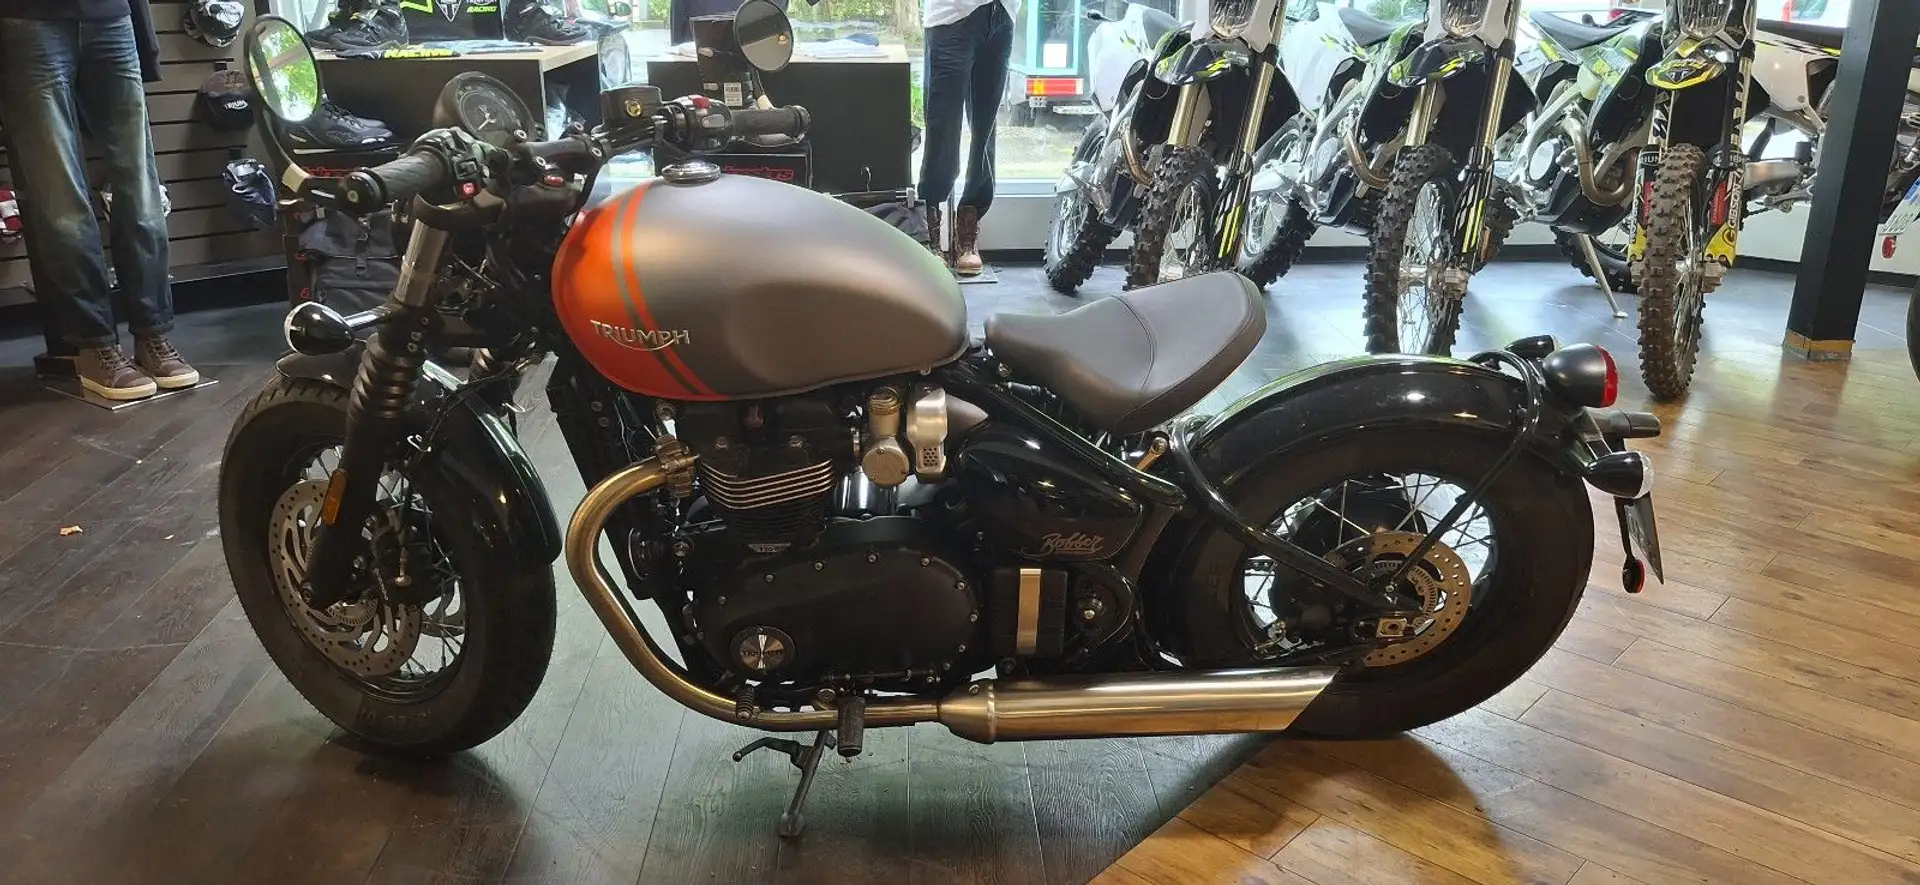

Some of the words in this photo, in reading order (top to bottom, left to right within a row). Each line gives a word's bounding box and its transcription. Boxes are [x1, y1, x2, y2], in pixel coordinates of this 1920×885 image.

[466, 6, 498, 14] RACING
[1727, 183, 1742, 229] GIBSON
[590, 319, 691, 352] TRIUMPH
[1037, 532, 1105, 555] Bobber
